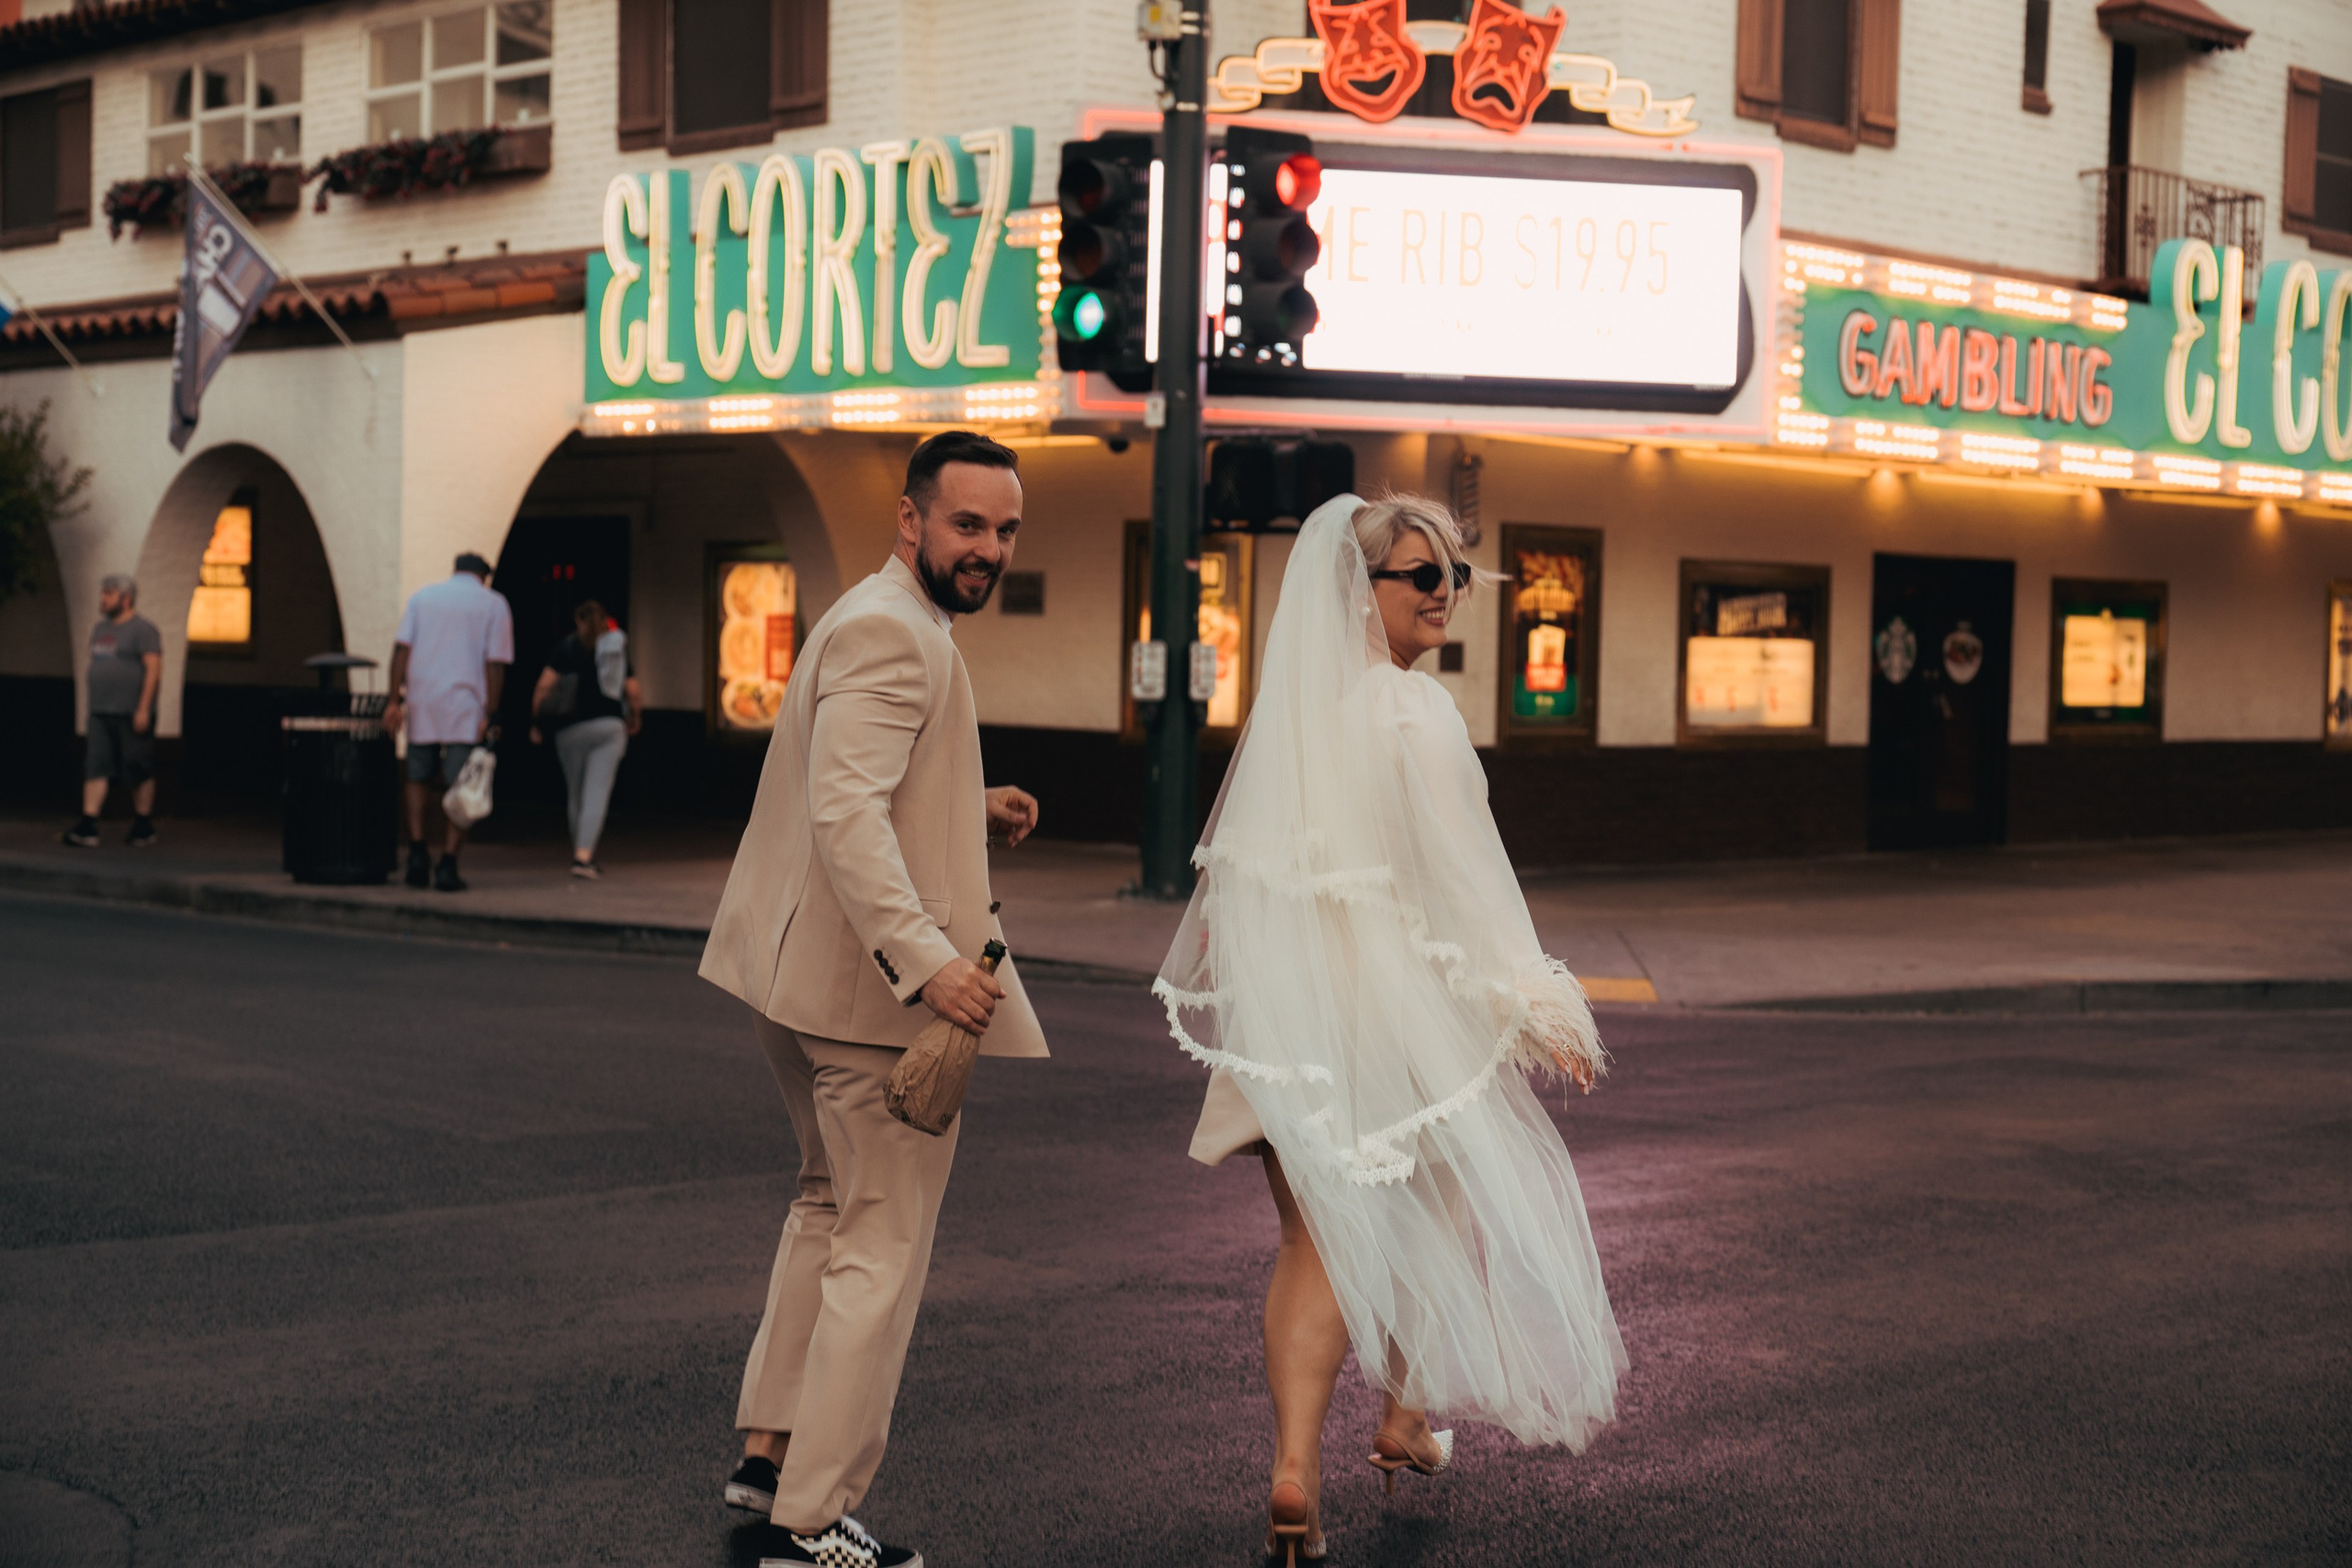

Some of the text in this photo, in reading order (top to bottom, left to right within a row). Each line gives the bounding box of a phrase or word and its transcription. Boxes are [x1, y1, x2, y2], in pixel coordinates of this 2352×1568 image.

[600, 128, 1010, 387] EL CORTEZ
[1401, 209, 1484, 287] RIB
[1838, 310, 2113, 428] GAMBLING
[2165, 238, 2252, 448] EL
